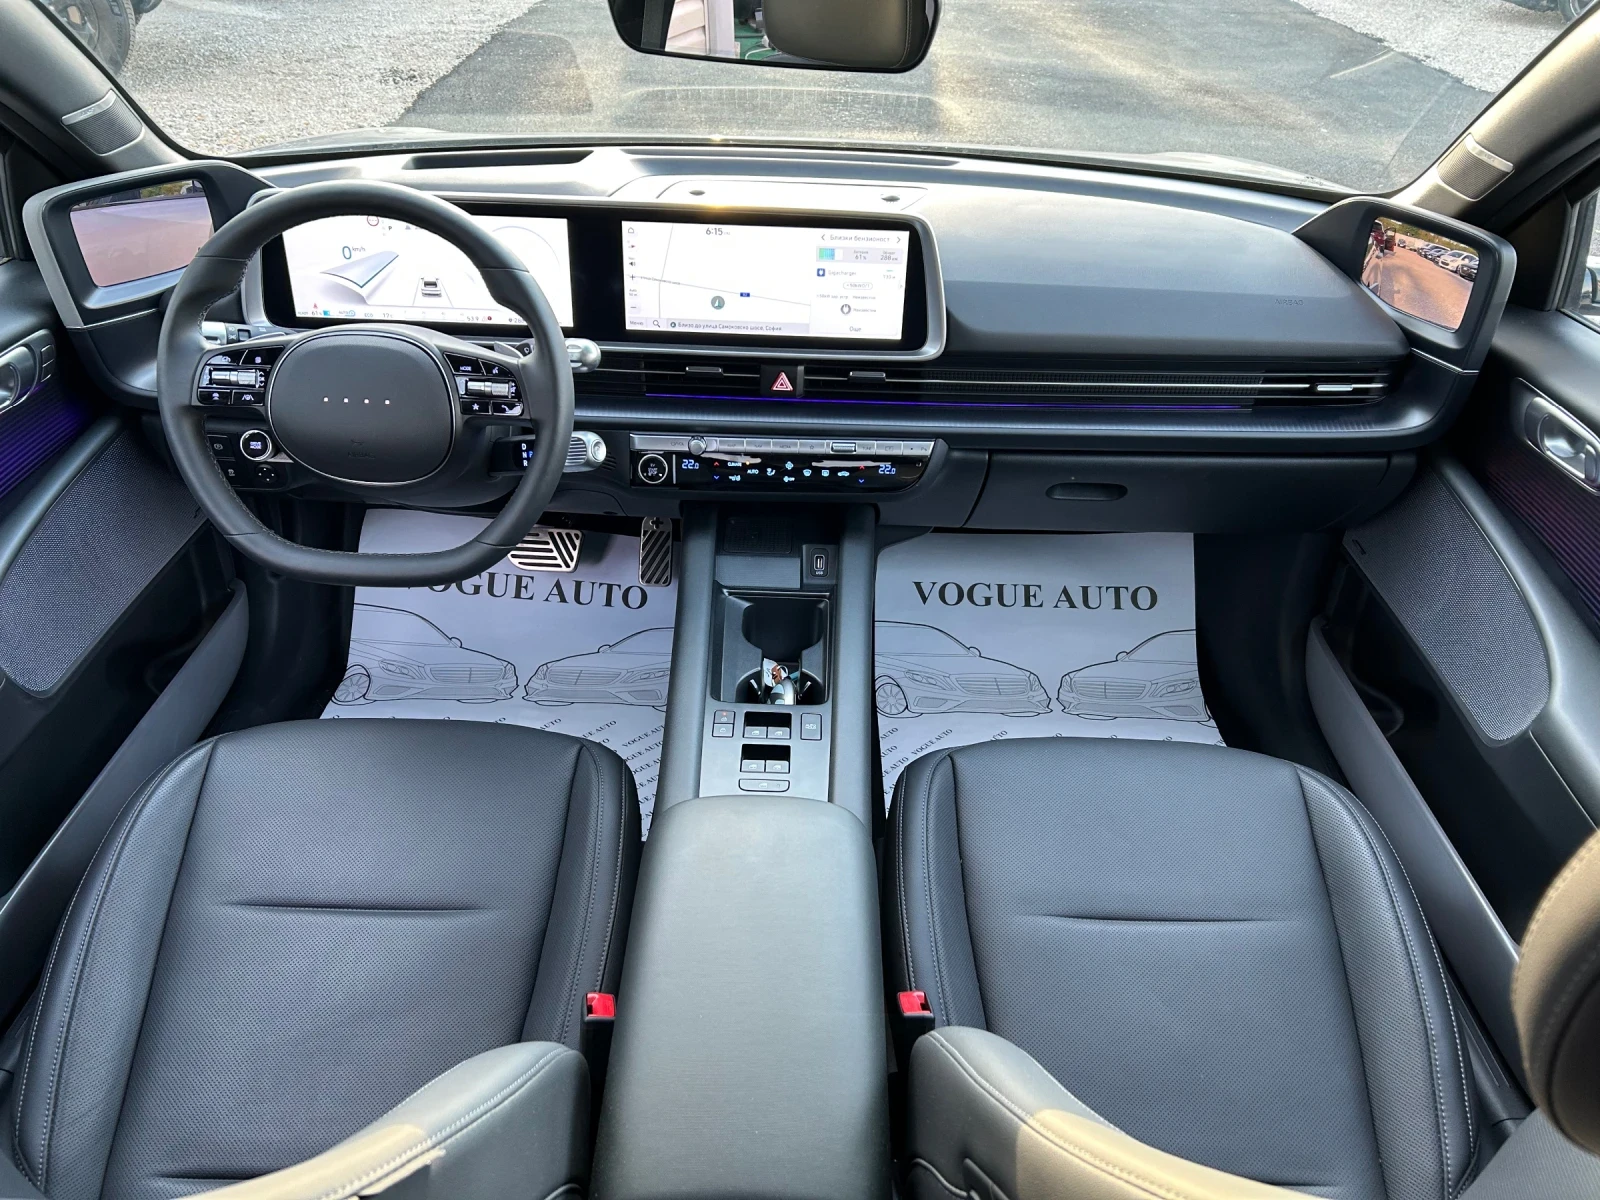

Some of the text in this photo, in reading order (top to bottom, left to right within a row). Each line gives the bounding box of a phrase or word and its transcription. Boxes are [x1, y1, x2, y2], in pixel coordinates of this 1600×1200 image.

[705, 227, 724, 236] 6:15
[342, 245, 352, 260] 0
[1274, 298, 1305, 306] AIRBAG
[682, 459, 700, 470] 22.0
[878, 464, 896, 474] 22.0
[408, 571, 648, 610] GUE AUTO
[912, 580, 1158, 611] VOGUE AUTO
[595, 720, 617, 733] AUTO
[622, 732, 651, 748] VOGUE
[650, 724, 664, 735] AUT
[880, 727, 898, 740] AUTO
[911, 728, 953, 756] VOGUE AUTO
[624, 750, 644, 762] GUE
[890, 756, 909, 771] AUTO
